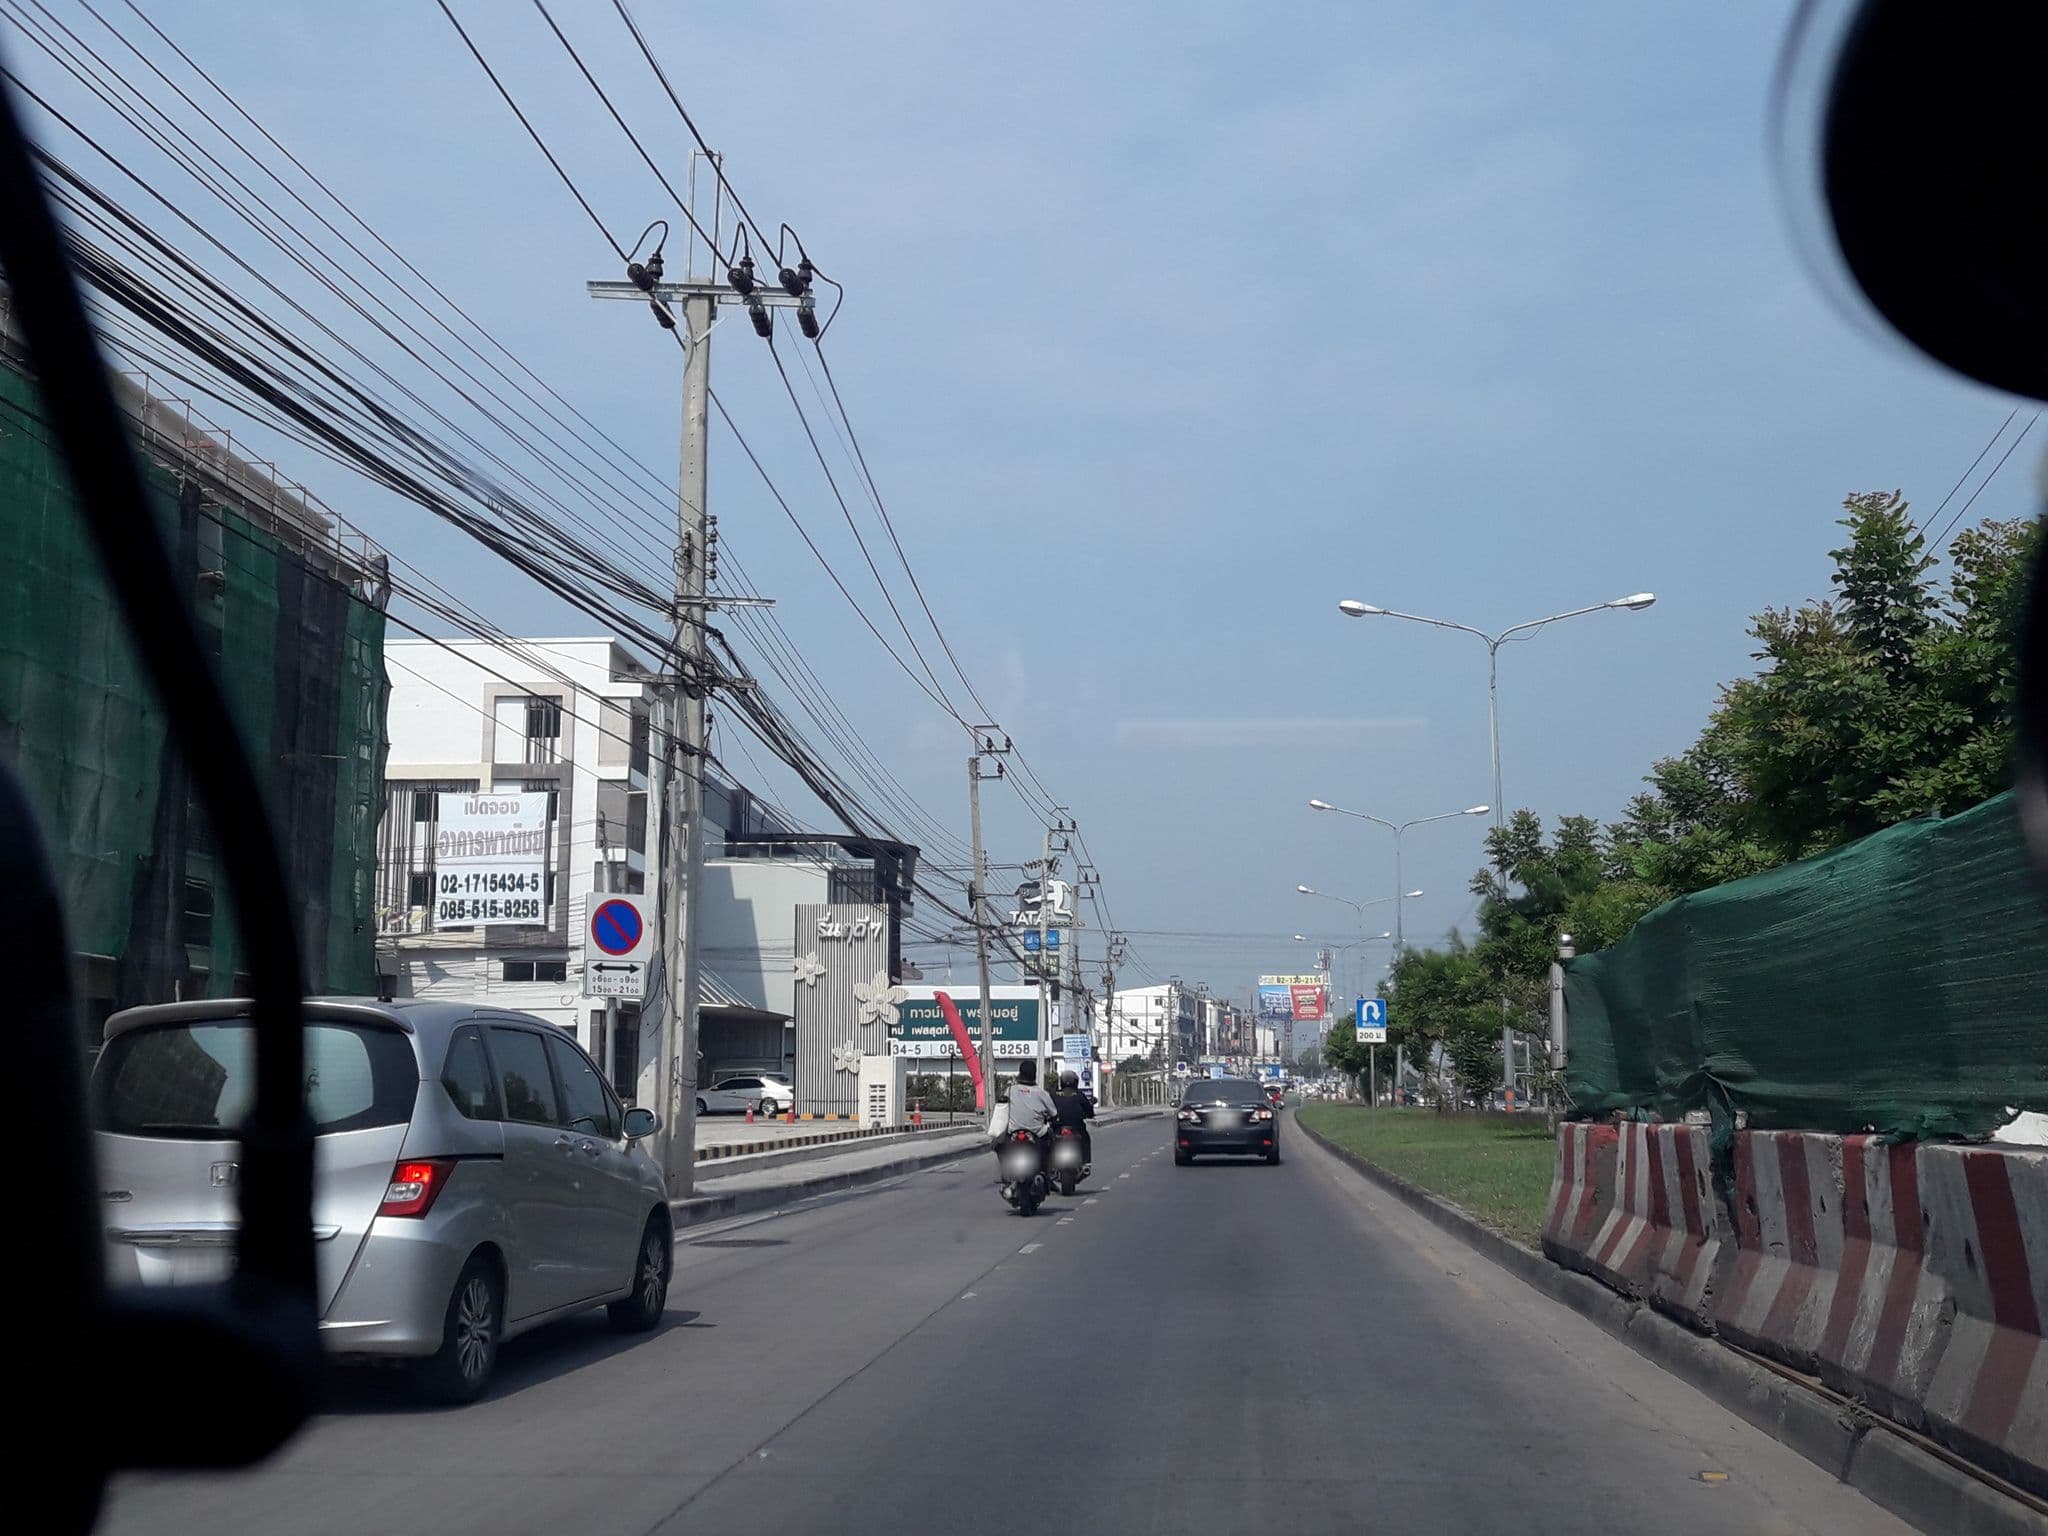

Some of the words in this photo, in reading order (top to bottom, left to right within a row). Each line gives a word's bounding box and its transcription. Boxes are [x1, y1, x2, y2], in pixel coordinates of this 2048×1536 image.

[440, 873, 539, 894] 02-1715434-5
[440, 899, 540, 920] 085-515-8258
[1359, 1032, 1374, 1040] 200
